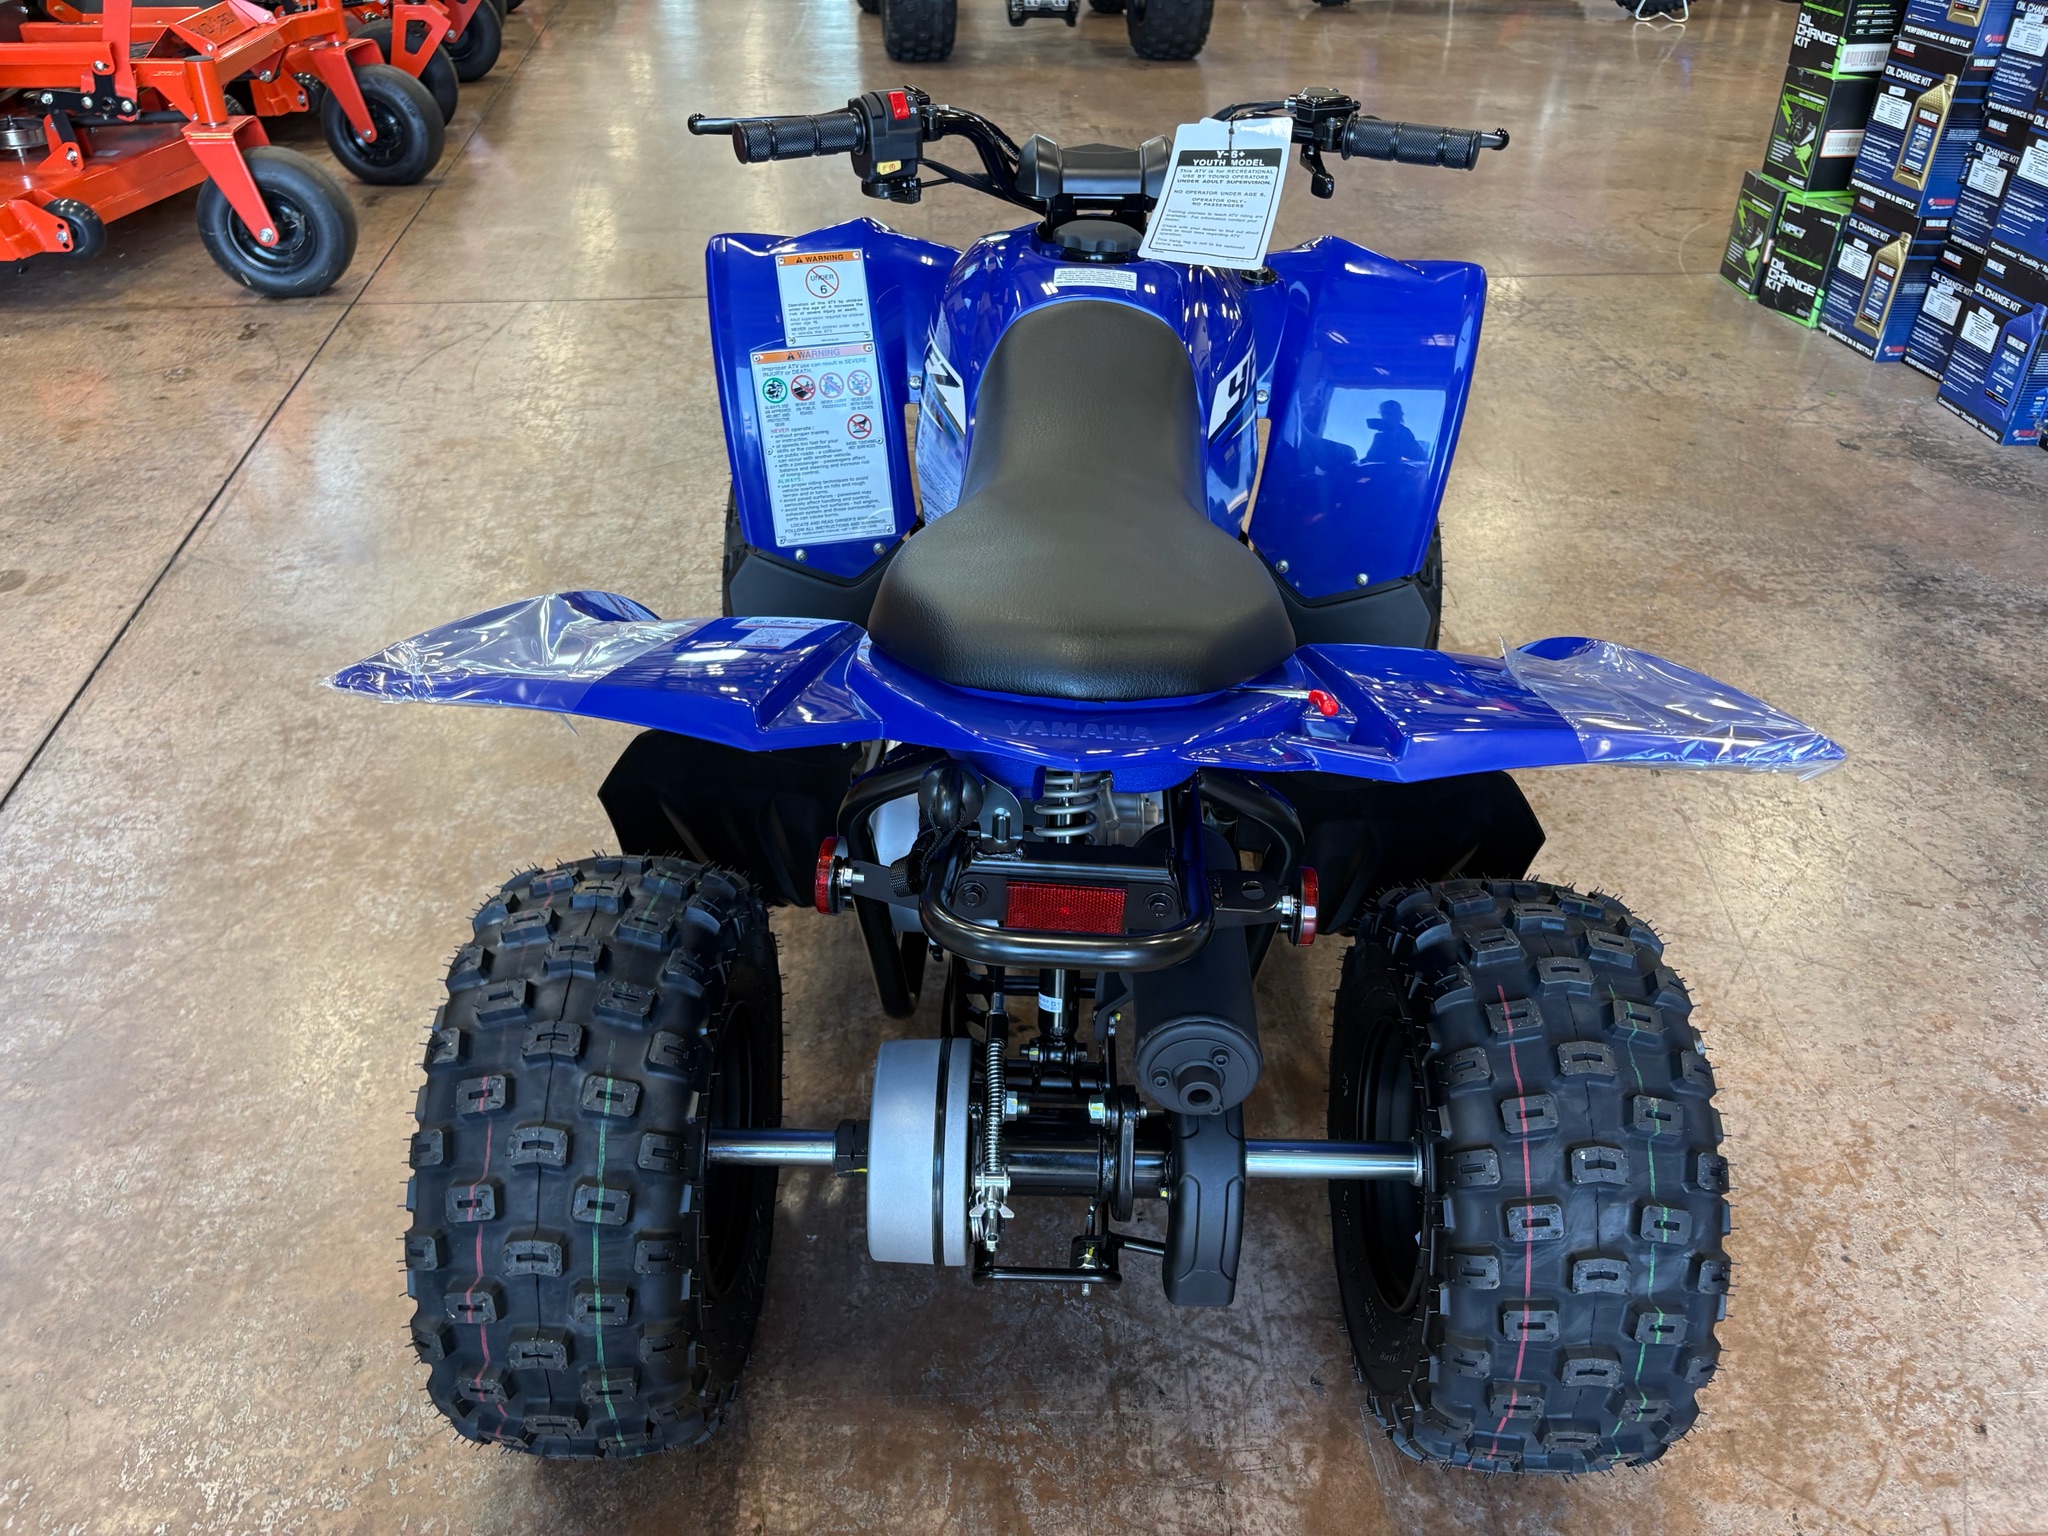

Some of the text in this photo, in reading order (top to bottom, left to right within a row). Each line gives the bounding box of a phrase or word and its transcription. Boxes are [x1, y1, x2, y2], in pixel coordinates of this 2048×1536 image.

[2016, 1, 2026, 11] OIL
[1799, 12, 1814, 27] OIL
[1794, 35, 1811, 48] KIT
[1796, 24, 1838, 46] CHANGE
[1904, 25, 1939, 40] PERFORMANCE
[1949, 37, 1971, 48] BOTTLE
[1885, 66, 1932, 87] OIL CHANGE KIT
[1988, 101, 2027, 119] PERFORMANCE
[2033, 115, 2044, 127] OIL
[1975, 142, 1985, 151] OIL
[2009, 153, 2020, 165] KIT
[1849, 217, 1859, 228] OIL
[1858, 221, 1881, 238] CHANGE
[1880, 232, 1890, 243] KIT
[1951, 234, 1984, 253] PERFORMANCE
[805, 254, 844, 263] WARNING
[1770, 257, 1788, 273] OIL
[820, 285, 827, 294] 6
[1765, 278, 1784, 293] KIT
[1768, 267, 1817, 296] CHANGE
[1931, 271, 1941, 281] OIL
[1962, 287, 1974, 298] KIT
[1974, 283, 2022, 313] OIL CHANGE KIT
[797, 348, 840, 359] WARNING
[762, 364, 786, 372] Improper
[1005, 720, 1154, 742] YAMAHA
